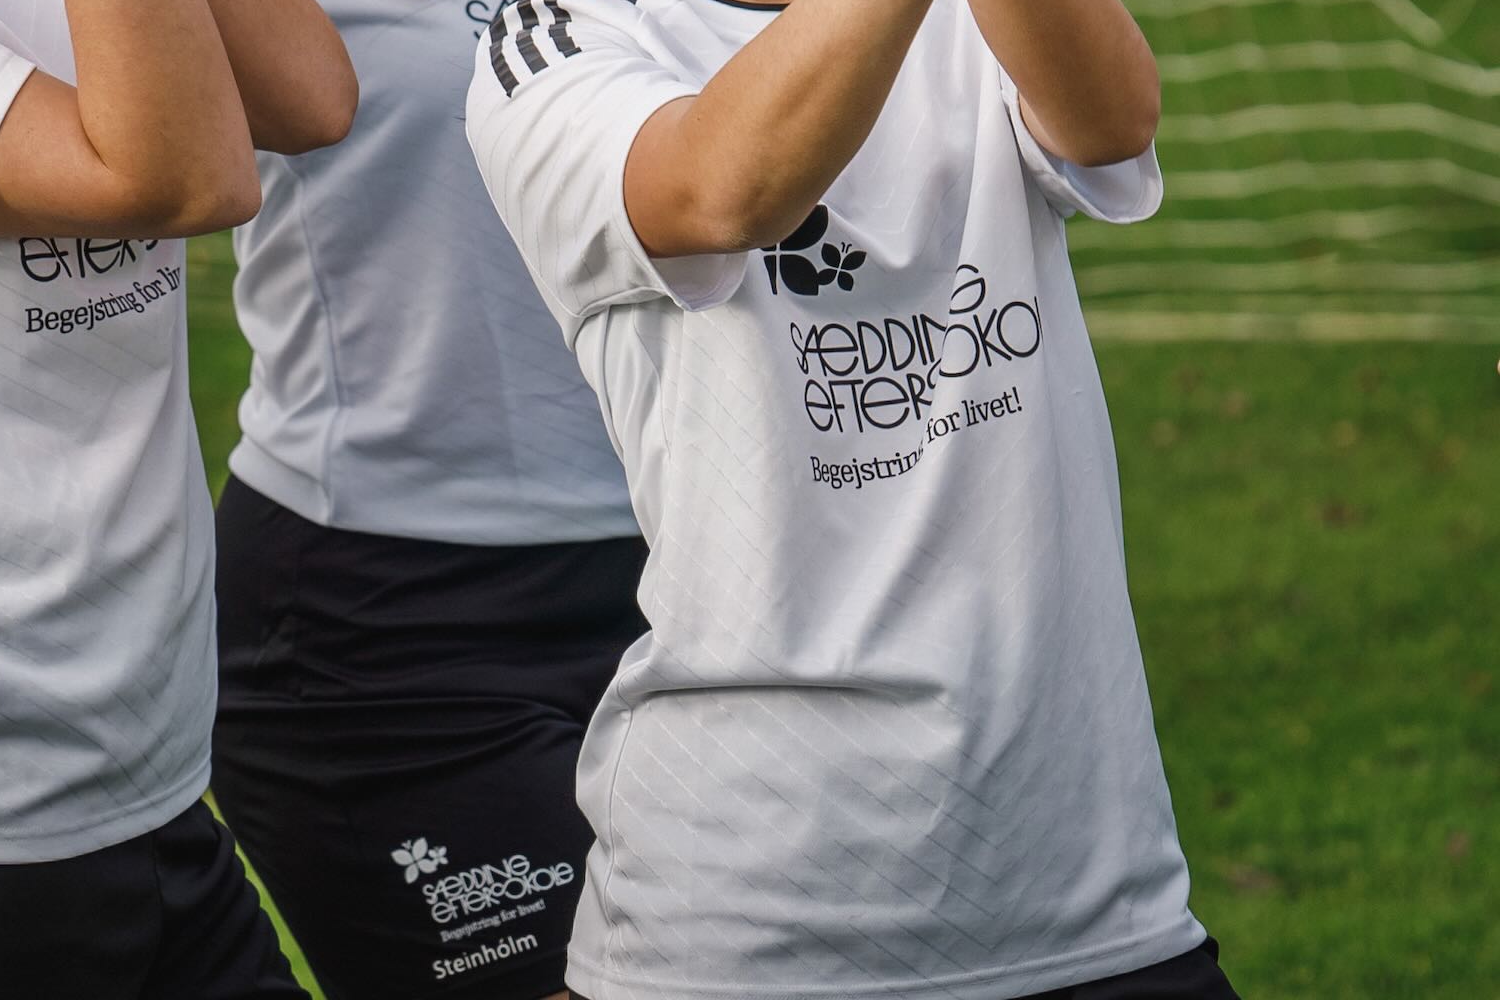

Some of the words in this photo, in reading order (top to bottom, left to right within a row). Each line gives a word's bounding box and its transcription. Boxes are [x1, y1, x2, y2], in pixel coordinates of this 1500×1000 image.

[25, 293, 145, 333] Begejstring
[133, 281, 167, 304] for
[926, 411, 960, 443] for
[962, 387, 1022, 427] livet!
[500, 908, 517, 922] for
[432, 933, 538, 979] Steinhólm
